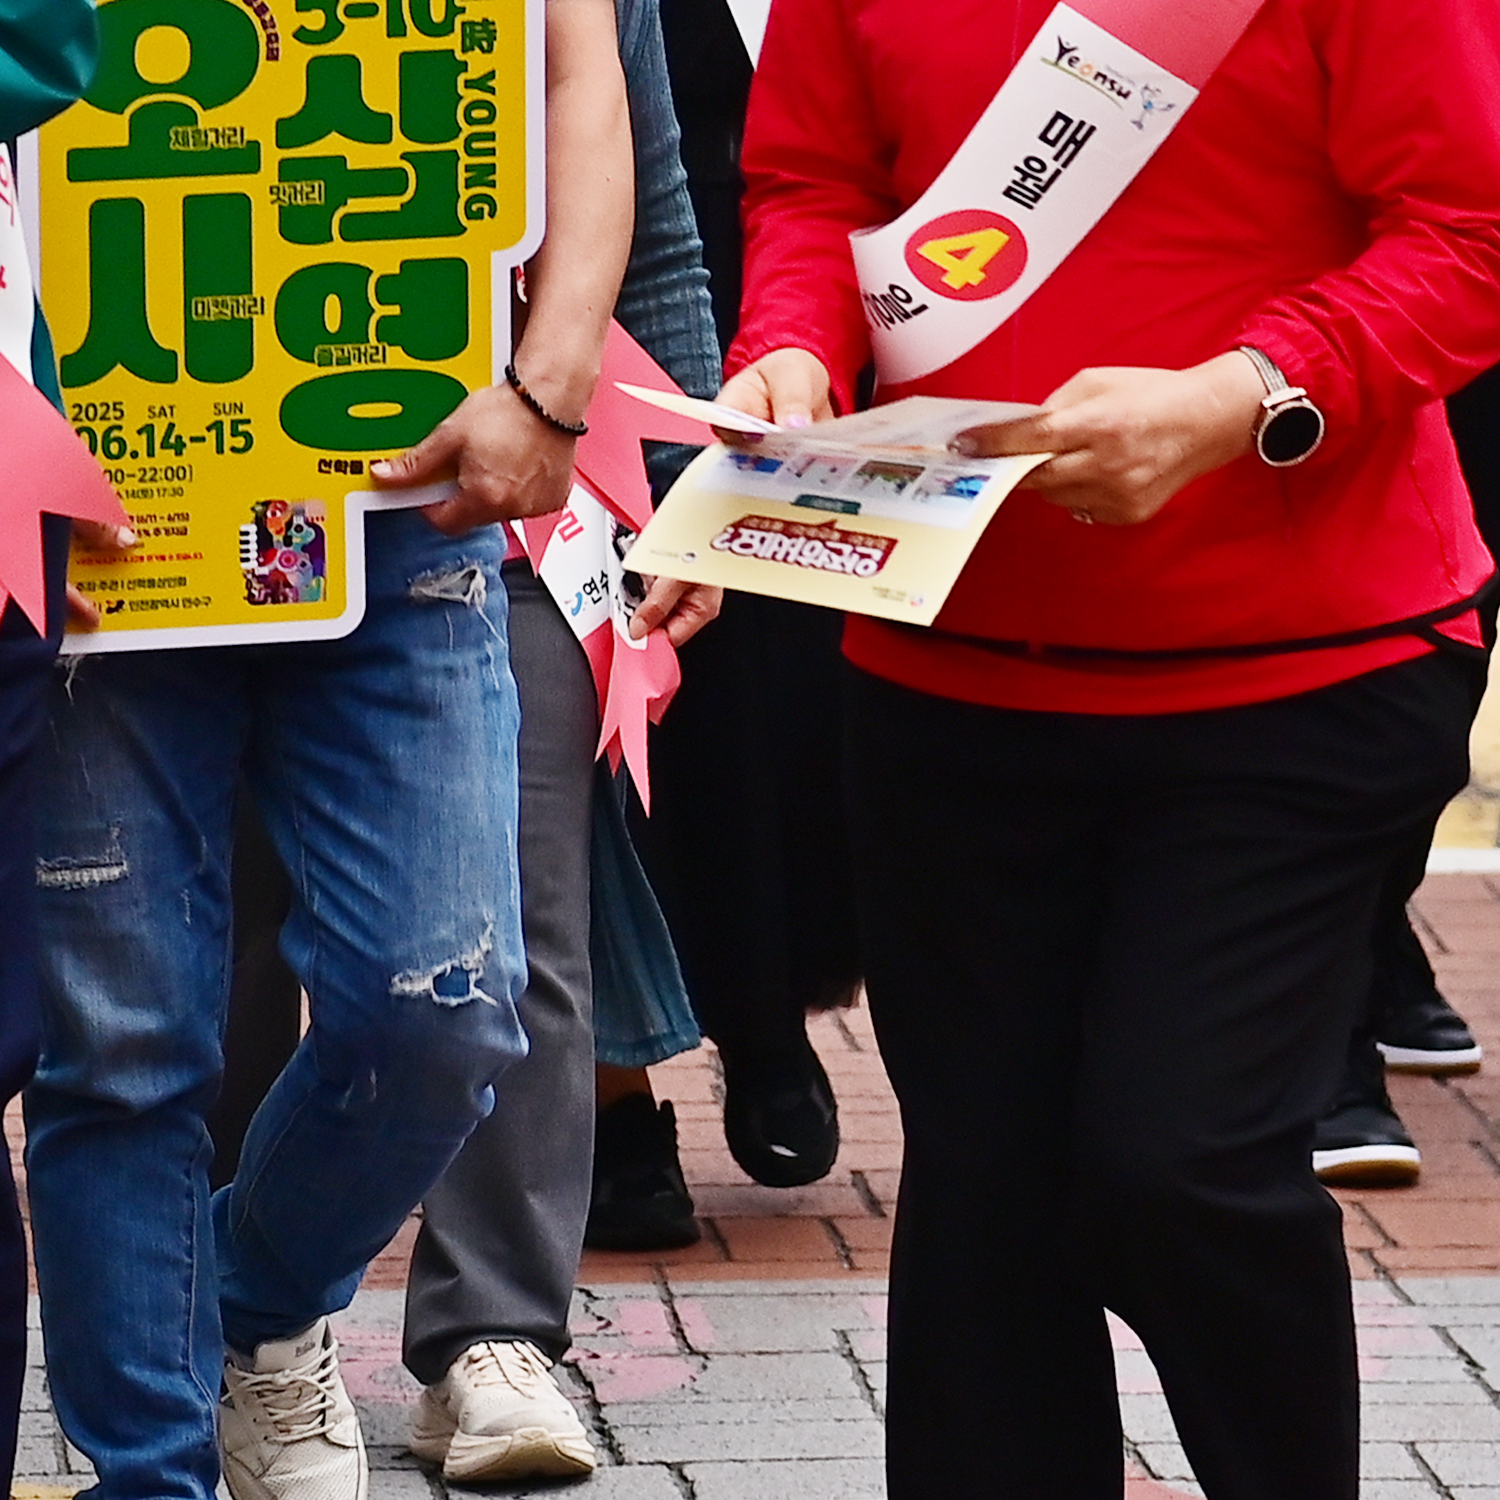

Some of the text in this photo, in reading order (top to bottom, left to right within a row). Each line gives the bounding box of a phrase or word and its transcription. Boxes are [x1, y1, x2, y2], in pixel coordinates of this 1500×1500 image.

[1050, 33, 1131, 106] Yeonsu
[462, 69, 498, 222] YOUNG
[1001, 110, 1097, 211] 매월
[914, 226, 1011, 291] 4
[71, 402, 126, 422] 2025
[75, 418, 255, 460] 06.14-15
[147, 402, 245, 420] SAT SUN
